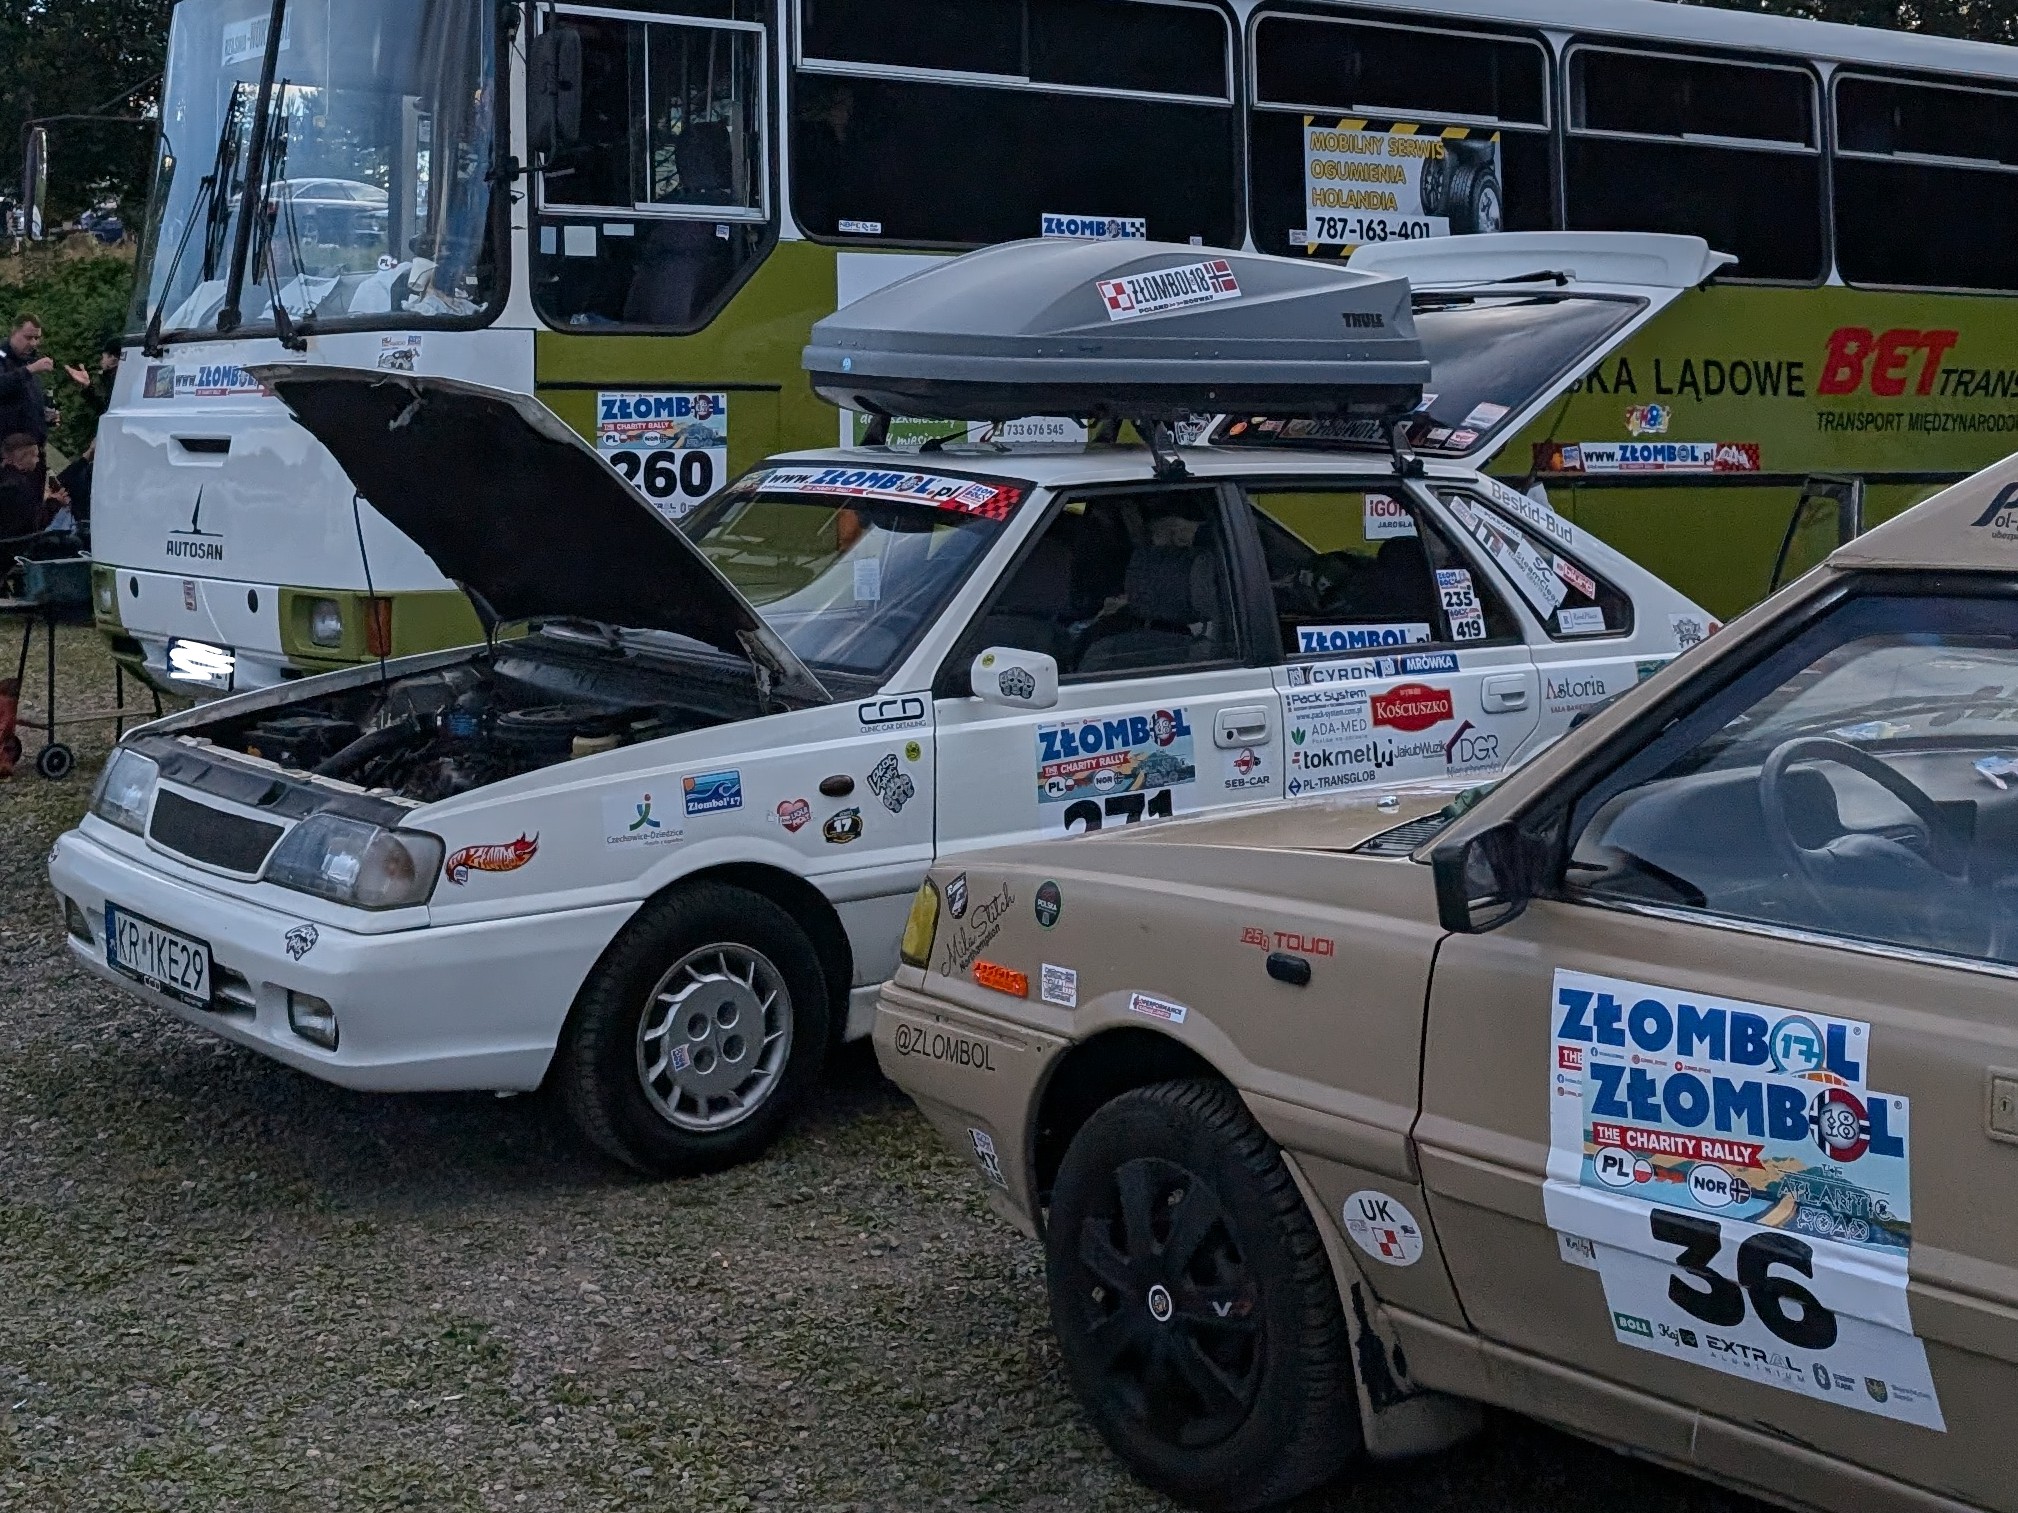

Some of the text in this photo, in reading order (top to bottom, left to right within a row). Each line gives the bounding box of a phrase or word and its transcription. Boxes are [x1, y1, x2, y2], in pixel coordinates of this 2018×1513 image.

[1310, 132, 1445, 160] MOBILNY SERWIS
[1310, 160, 1407, 185] OGUMIENIA
[1311, 188, 1398, 211] HOLANDIA
[1043, 217, 1131, 238] ZŁOMBOL
[1315, 217, 1430, 241] 787-163-401
[1342, 312, 1385, 329] THULE
[1816, 326, 1960, 397] BET
[1654, 358, 1806, 403] LĄDOWE
[601, 394, 725, 421] ZŁOMBOL
[617, 422, 647, 431] CHARITY
[649, 421, 670, 430] RALLY
[1007, 424, 1064, 436] 733 676 545
[1816, 411, 1904, 433] TRANSPORT
[605, 435, 618, 443] PL
[609, 450, 714, 499] 260
[1490, 480, 1574, 546] Beskid-Bud
[166, 540, 224, 562] AUTOSAN
[1443, 591, 1473, 608] 235
[1456, 620, 1482, 639] 419
[1406, 653, 1454, 672] MRÓWKA
[1313, 666, 1377, 684] CYRON
[1546, 675, 1606, 699] Astoria
[1291, 689, 1367, 705] Pack System
[881, 723, 895, 731] CAR
[1039, 708, 1192, 763] ZŁOMBOL
[1312, 718, 1368, 736] ADA-MED
[1303, 743, 1372, 770] tokmet
[1460, 734, 1499, 763] DGR
[1060, 758, 1098, 775] CHARITY
[1100, 753, 1125, 767] RALLY
[1048, 775, 1113, 793] PL NOR
[1224, 775, 1270, 789] SEB-CAR
[1303, 769, 1376, 791] PL-TRANSGLOB
[606, 829, 684, 845] Czechowice-Dziedzice
[833, 818, 853, 833] 17
[1037, 898, 1058, 911] POLSKA
[117, 916, 204, 991] KR 1KE29
[1557, 986, 1860, 1083] ZŁOMBOL
[895, 1023, 996, 1072] @ZLOMBOL
[1590, 1060, 1905, 1159] ZŁOMBOL
[1597, 1126, 1754, 1166] THE CHARITY RALLY
[1601, 1155, 1728, 1196] PL NOR
[1358, 1198, 1396, 1223] UK
[1777, 1176, 1891, 1222] ATLANTIC
[1797, 1205, 1870, 1242] ROAD
[1650, 1208, 1838, 1351] 36
[1618, 1316, 1650, 1333] BOLL
[1705, 1334, 1803, 1373] EXTRAL
[1710, 1350, 1806, 1383] ALUMINIUM
